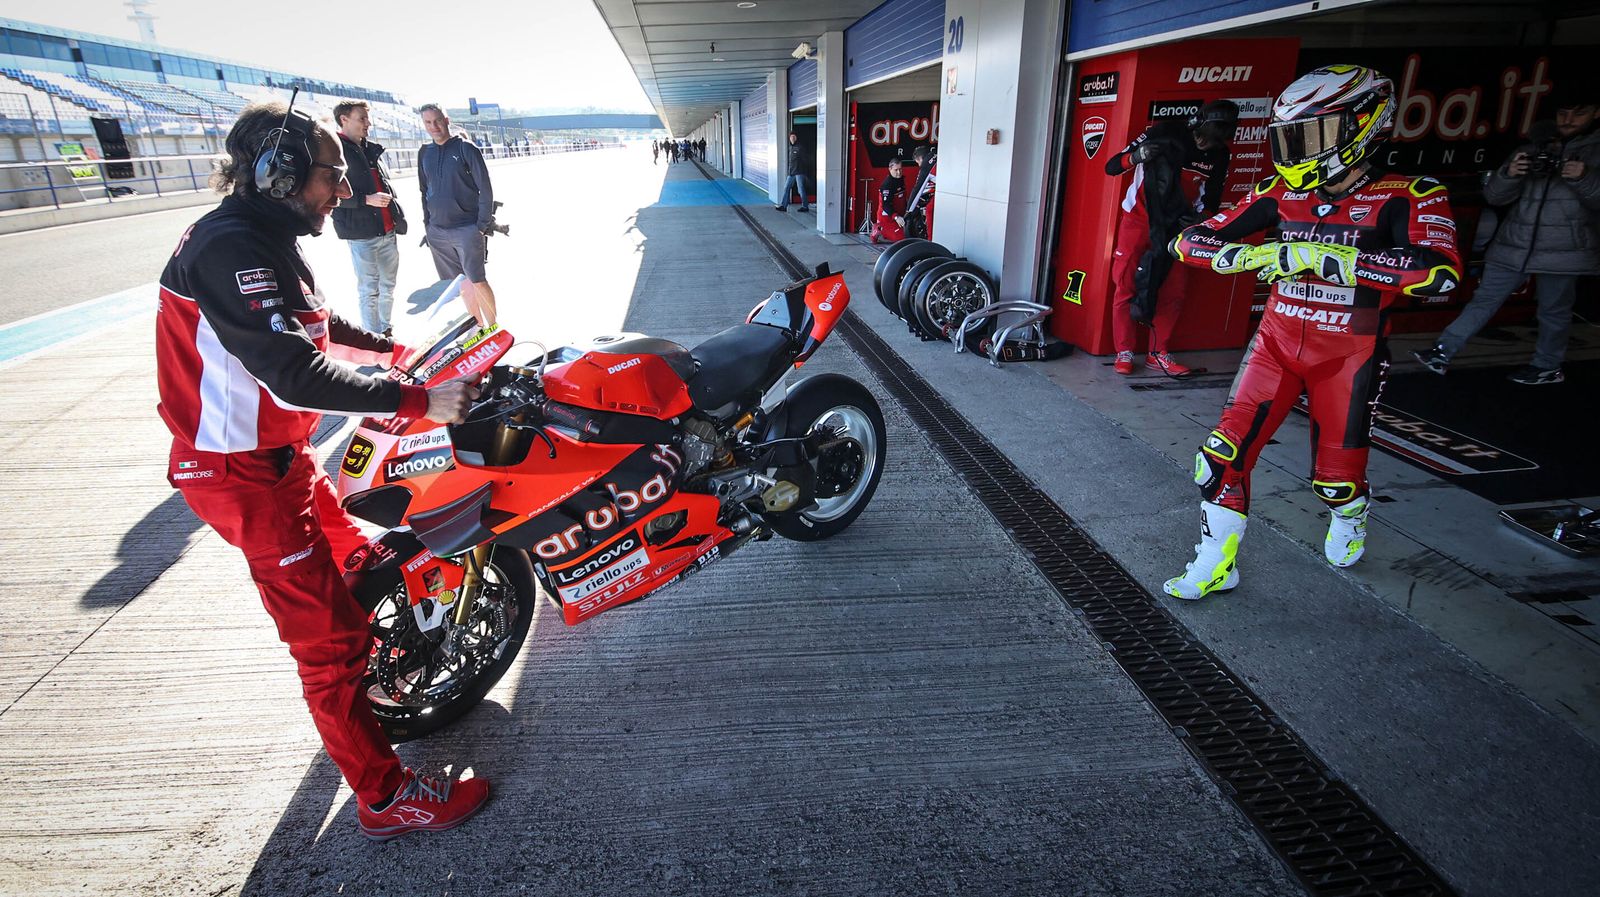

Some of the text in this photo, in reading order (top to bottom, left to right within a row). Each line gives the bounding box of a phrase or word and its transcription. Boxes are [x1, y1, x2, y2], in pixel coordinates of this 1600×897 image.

[947, 16, 964, 54] 20
[1178, 65, 1252, 83] DUCATI
[1239, 101, 1255, 112] iello
[1392, 57, 1551, 139] ba.it
[1152, 104, 1199, 118] Lenovo
[1084, 123, 1105, 131] DUCATI
[1233, 126, 1268, 141] FIAMM
[1387, 149, 1486, 166] CING
[1281, 192, 1309, 200] FIAMM
[1191, 249, 1217, 259] Lenov
[1354, 266, 1393, 284] Lenovo
[1290, 284, 1347, 302] riello ups
[1274, 301, 1352, 325] DUCATI
[1316, 323, 1348, 333] SBK
[455, 340, 500, 375] FIAMM
[607, 357, 641, 375] DUCATI
[431, 436, 446, 445] ups
[387, 455, 446, 478] Lenovo
[557, 538, 635, 584] Lenovo
[585, 567, 622, 593] riello
[623, 557, 642, 572] ups
[578, 571, 646, 613] STULZ
